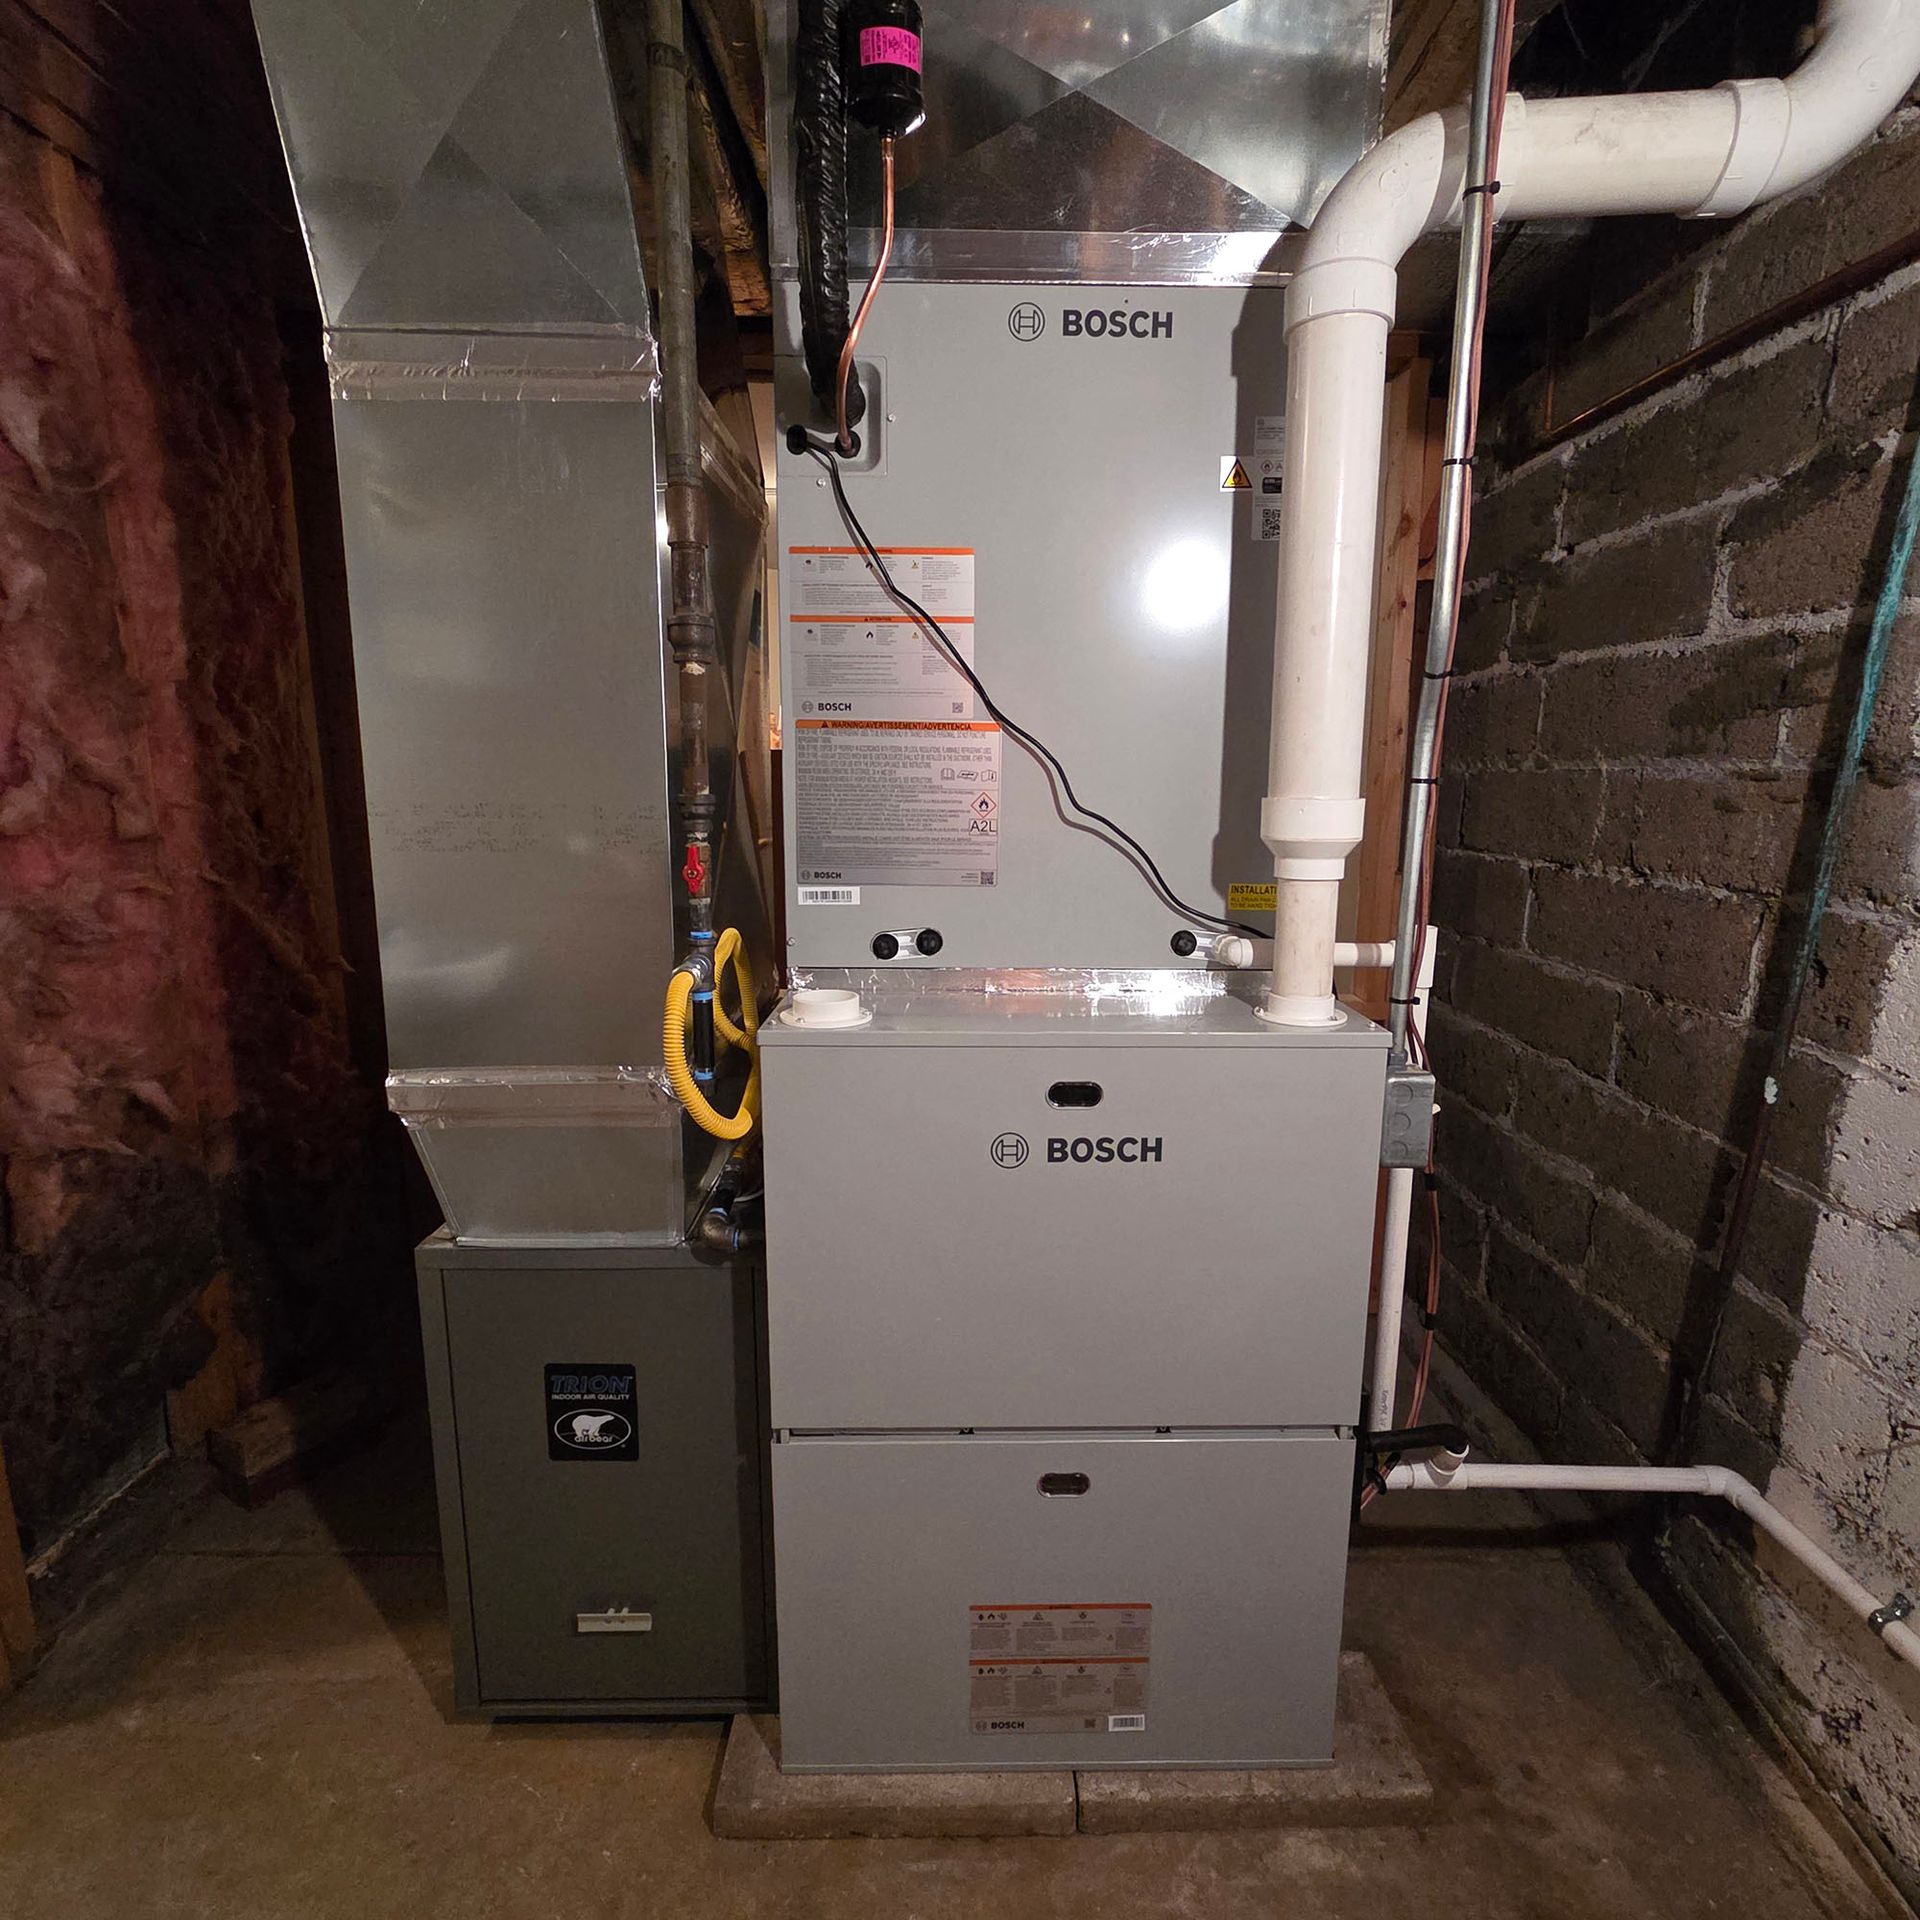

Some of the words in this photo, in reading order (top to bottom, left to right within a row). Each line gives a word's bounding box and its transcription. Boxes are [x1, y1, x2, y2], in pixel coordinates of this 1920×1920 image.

[1062, 309, 1173, 338] BOSCH
[818, 702, 852, 712] BOSCH
[970, 820, 997, 833] A2L
[814, 871, 842, 879] BOSCH
[1047, 1137, 1163, 1163] BOSCH
[551, 1375, 630, 1393] TRION
[991, 1721, 1025, 1729] BOSCH
